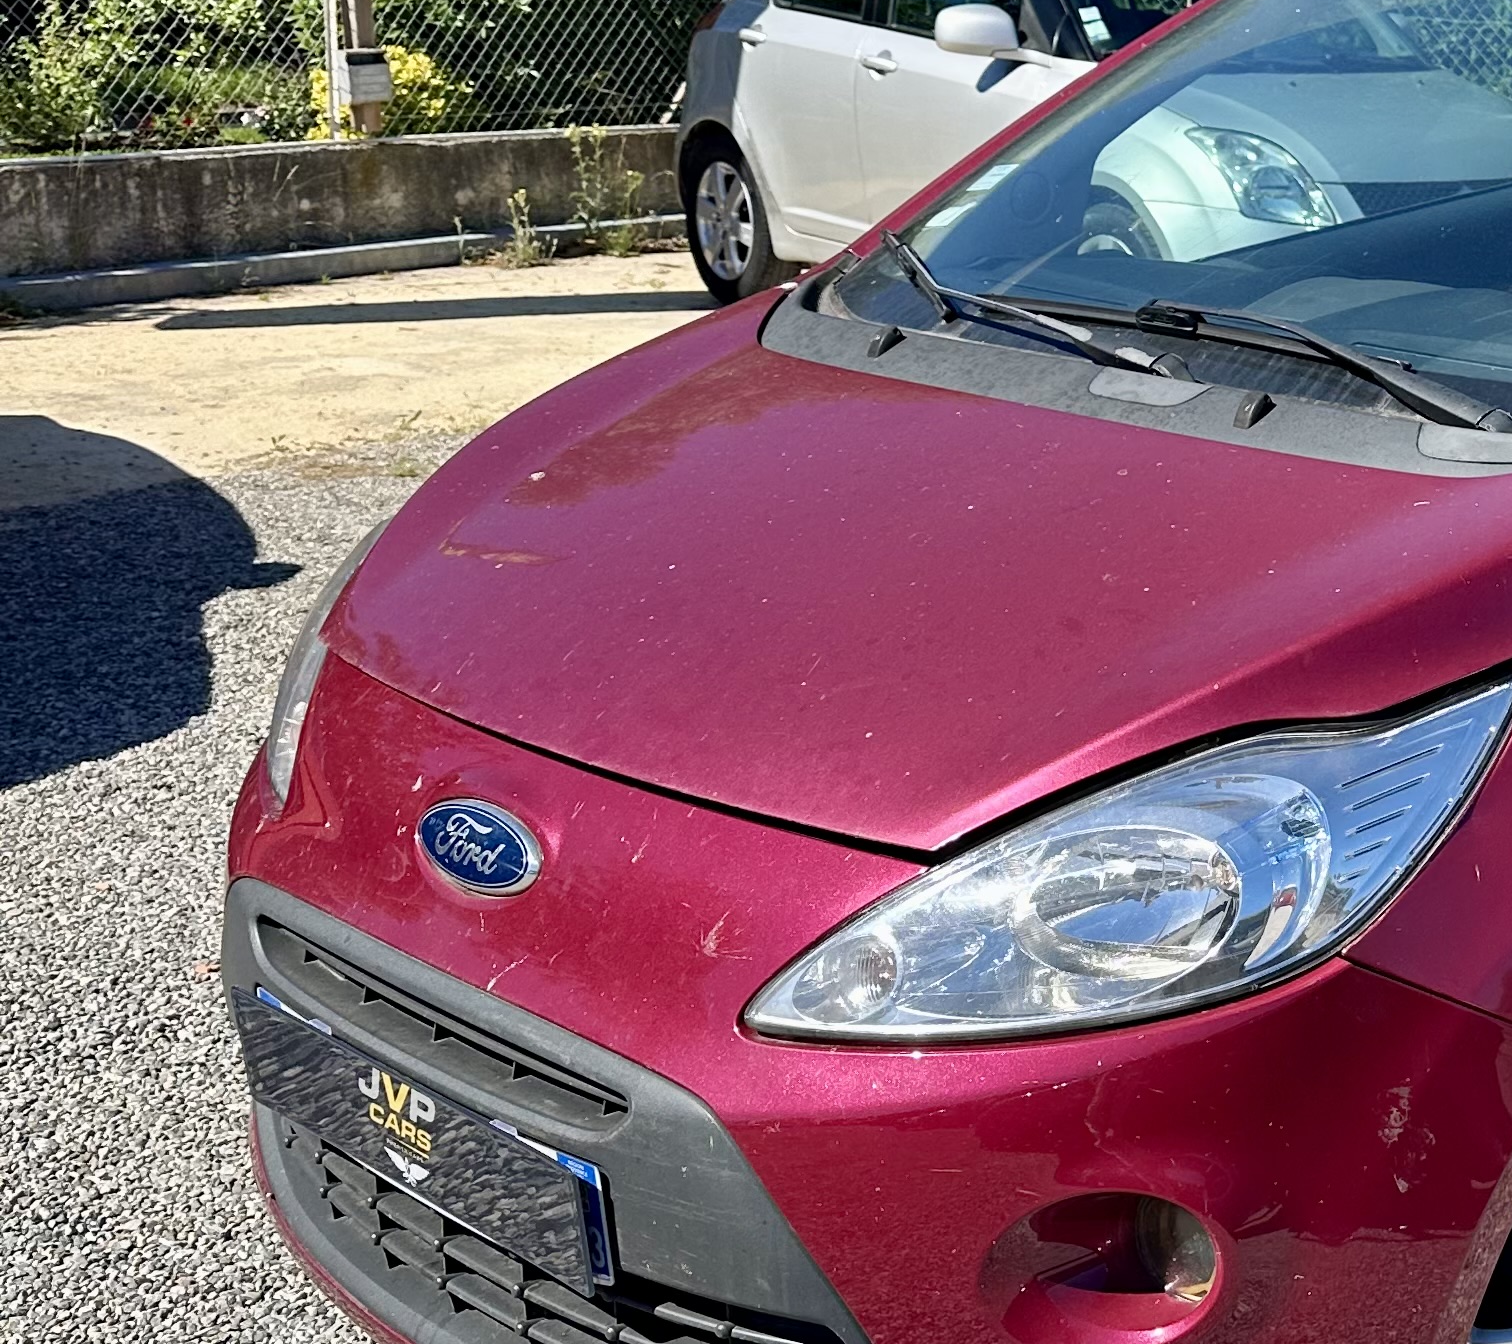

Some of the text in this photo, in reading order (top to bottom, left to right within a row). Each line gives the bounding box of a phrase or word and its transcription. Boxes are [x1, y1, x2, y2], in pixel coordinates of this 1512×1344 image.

[434, 813, 507, 875] Ford
[358, 1067, 436, 1123] JVP
[369, 1102, 432, 1152] CARS
